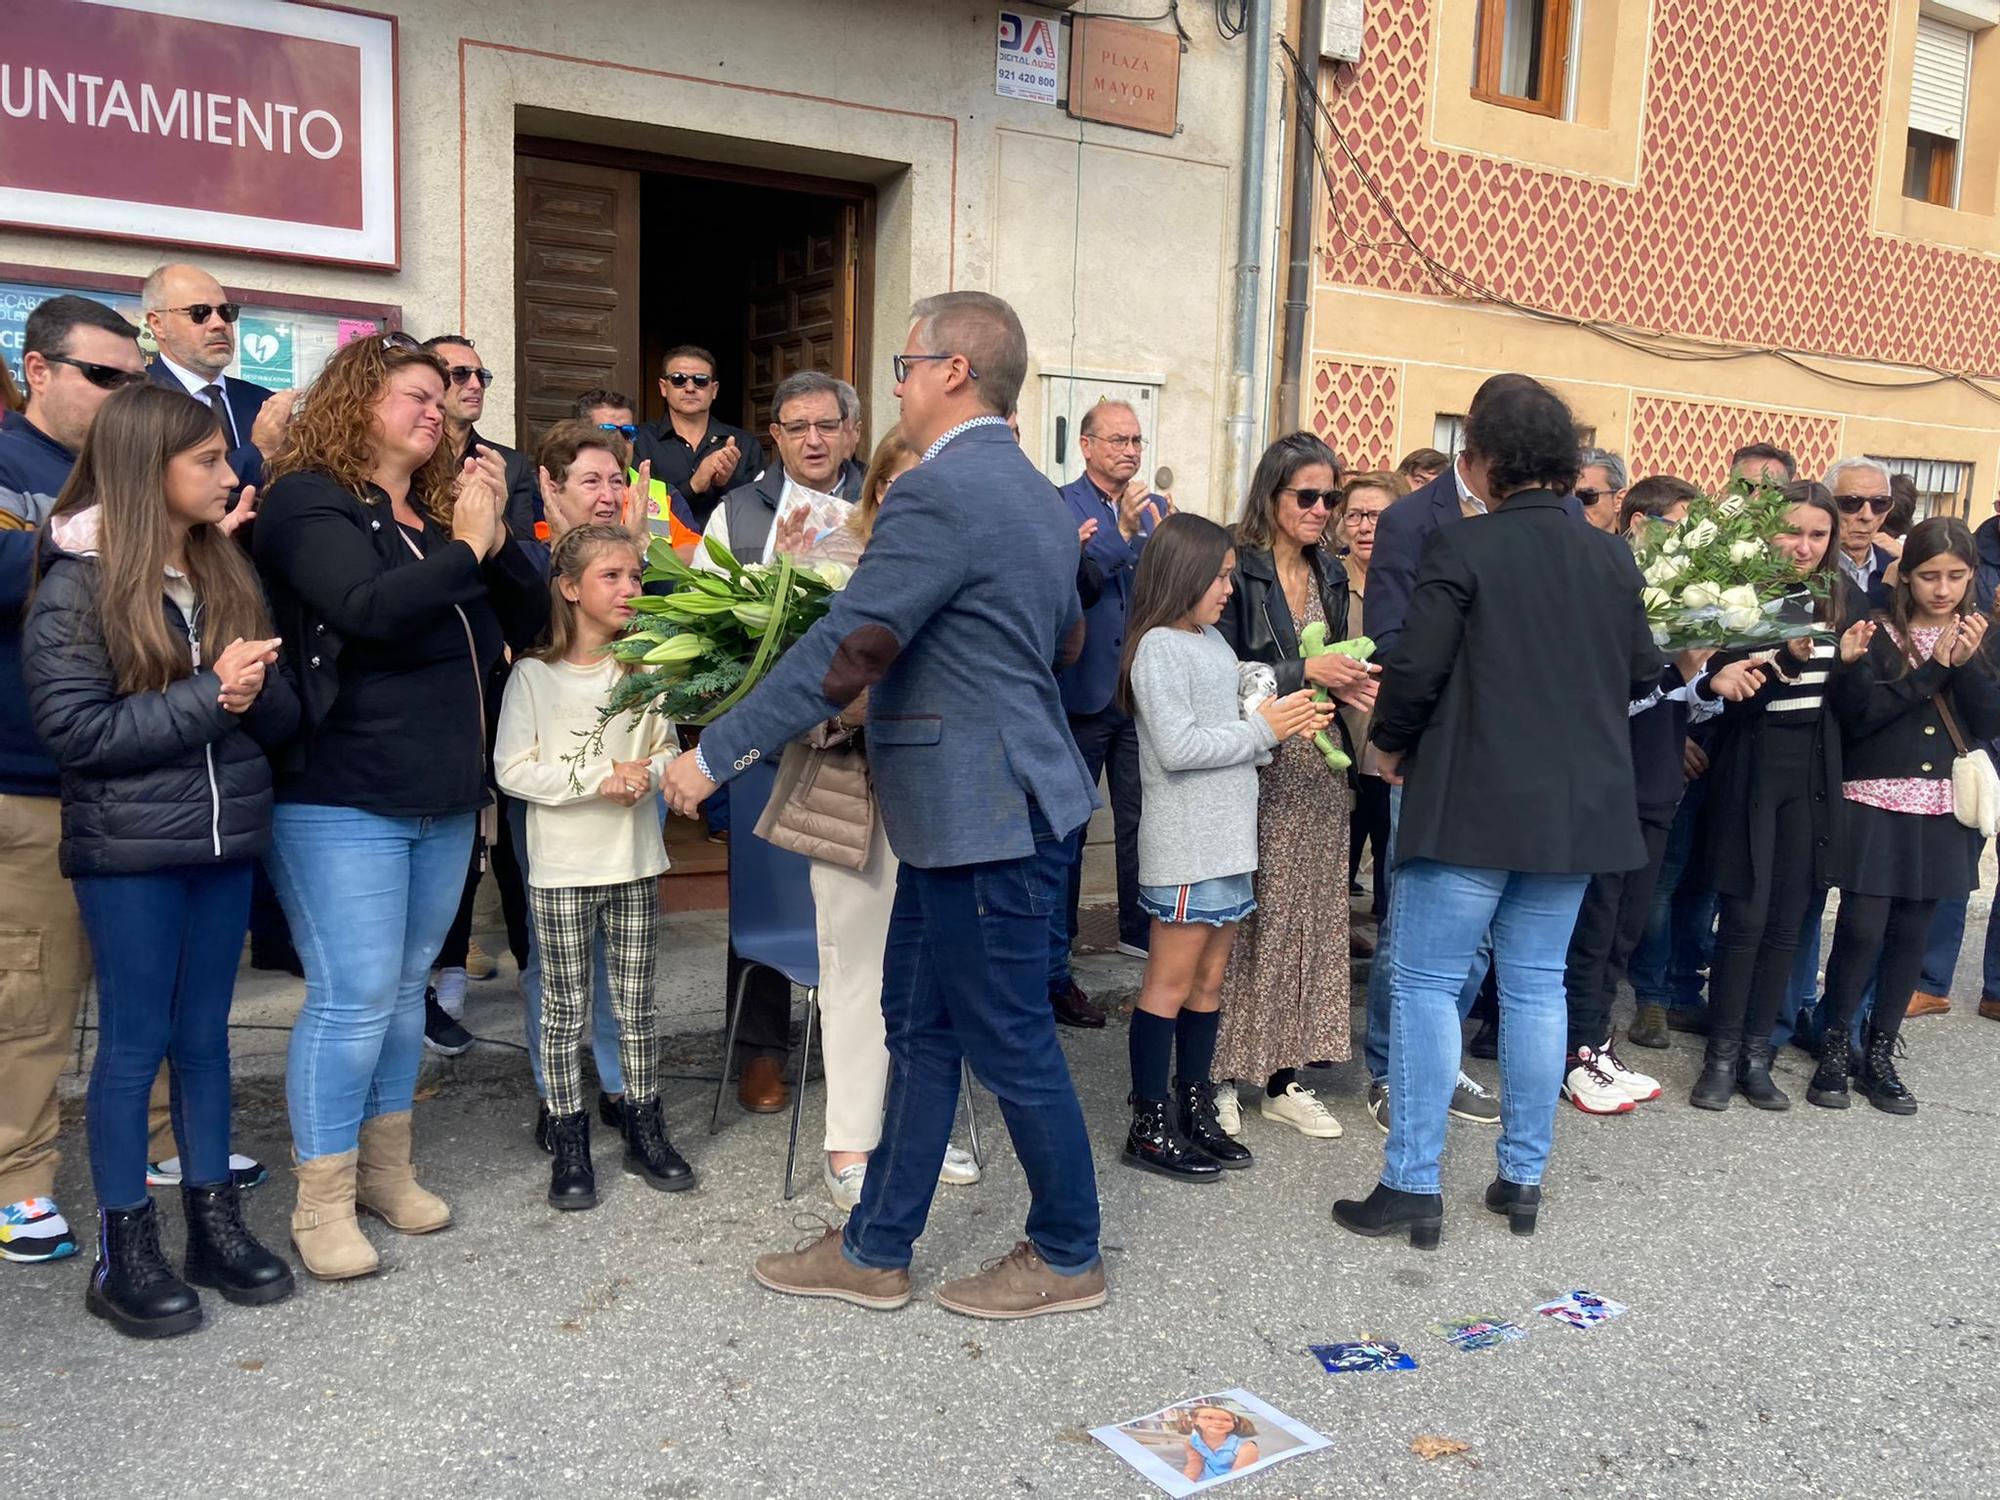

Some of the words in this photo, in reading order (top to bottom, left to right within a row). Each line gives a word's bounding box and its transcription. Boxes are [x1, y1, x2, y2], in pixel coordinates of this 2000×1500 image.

[999, 53, 1030, 65] DIGITAL
[1031, 59, 1056, 70] AUDIO
[1102, 50, 1150, 73] PLAZA
[998, 69, 1015, 80] 921
[1018, 73, 1036, 84] 420
[1038, 76, 1055, 88] 800
[1094, 77, 1157, 101] MAYOR
[1, 63, 343, 160] UNTAMIENTO
